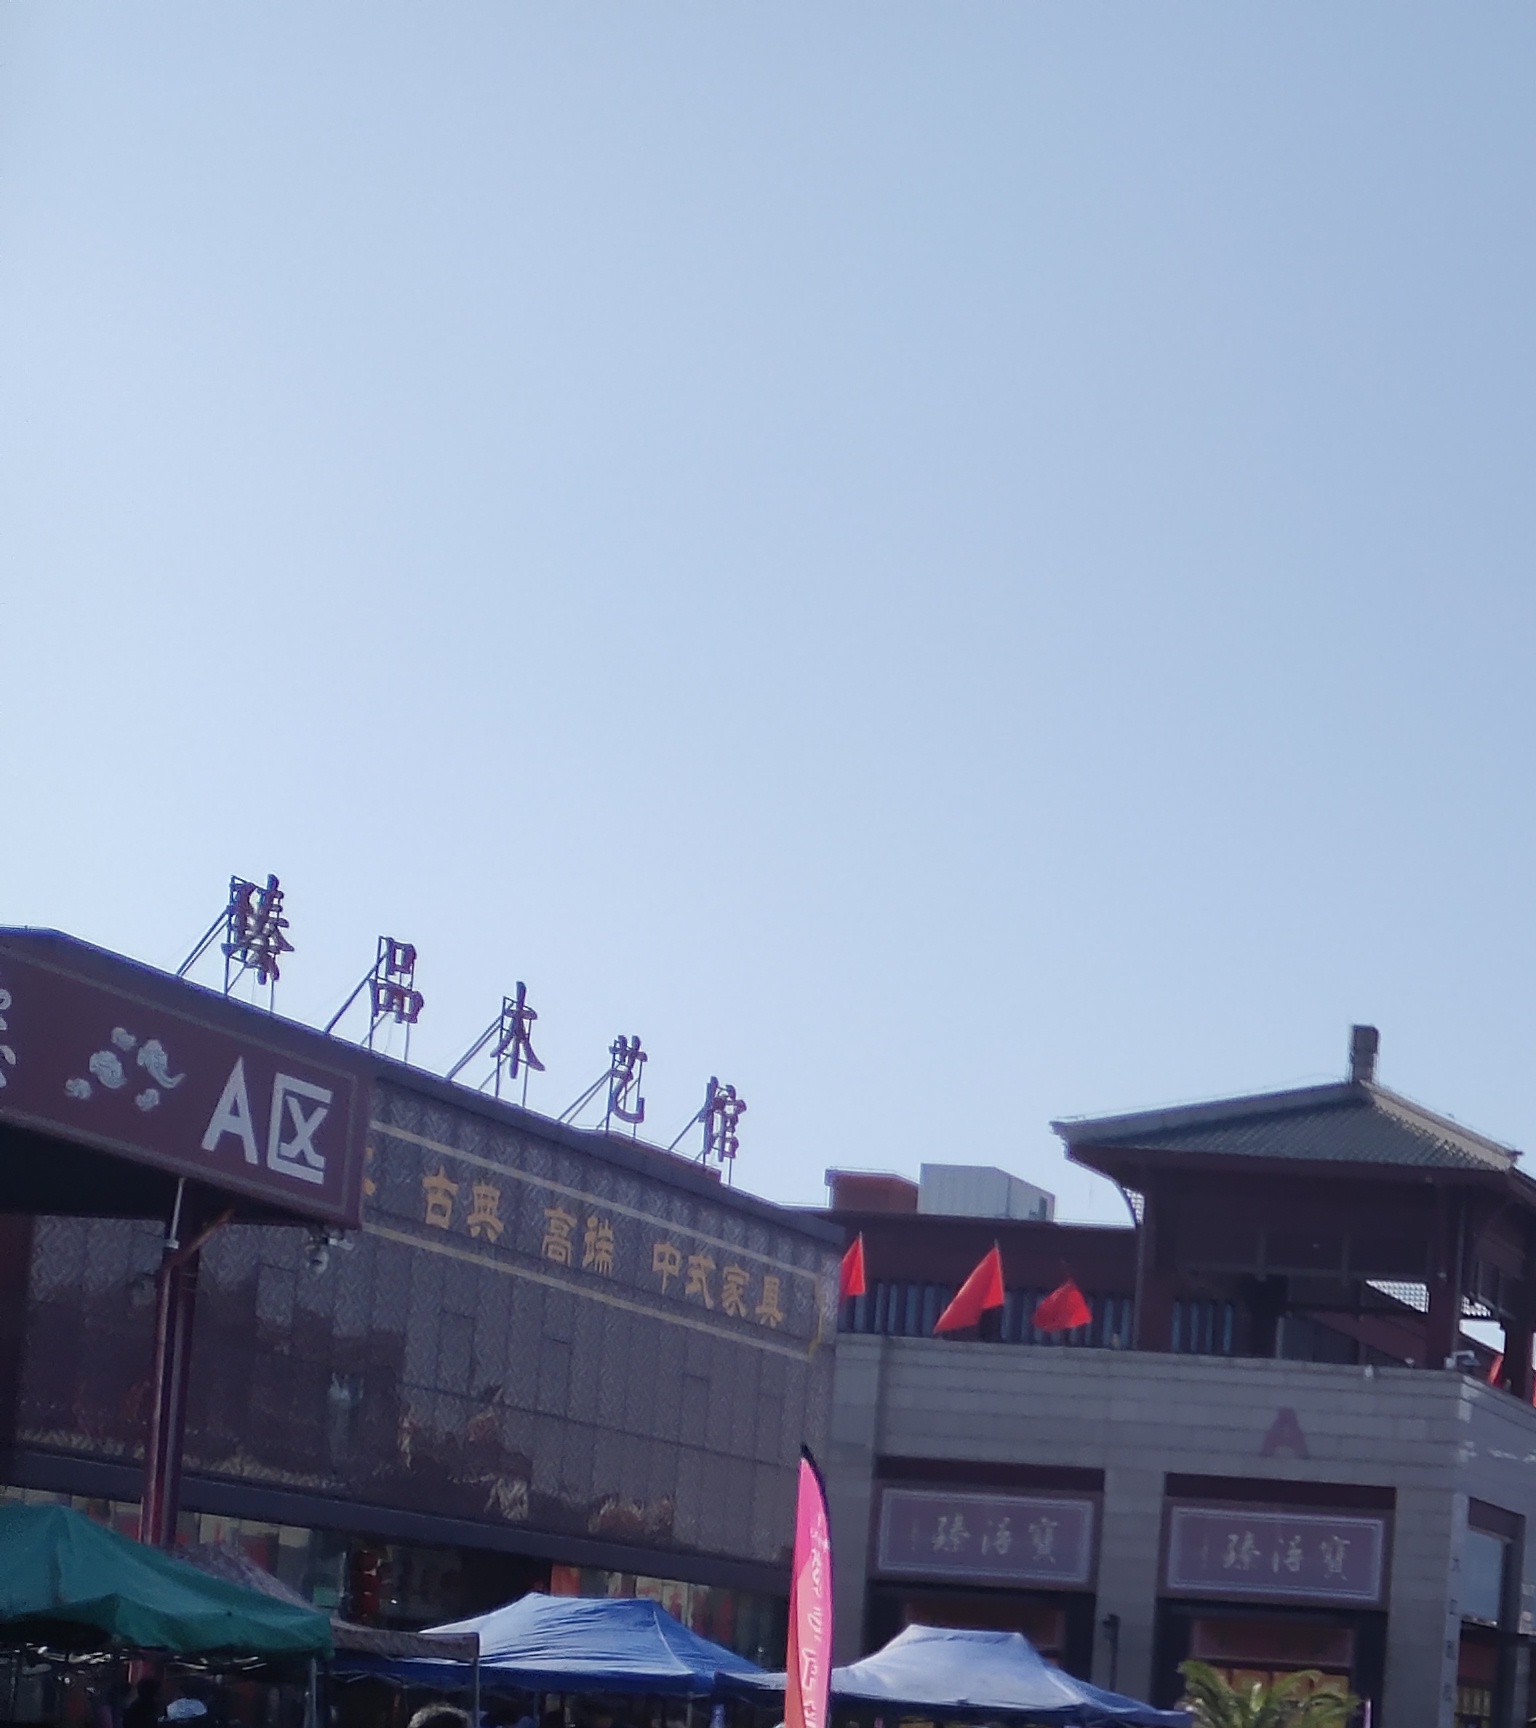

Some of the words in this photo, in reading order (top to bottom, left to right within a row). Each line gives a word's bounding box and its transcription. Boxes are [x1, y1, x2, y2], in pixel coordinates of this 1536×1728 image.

[202, 1056, 333, 1184] A区
[421, 1165, 504, 1242] 古典
[542, 1206, 614, 1275] 高端
[652, 1240, 784, 1327] 中式家具
[1259, 1407, 1310, 1459] A
